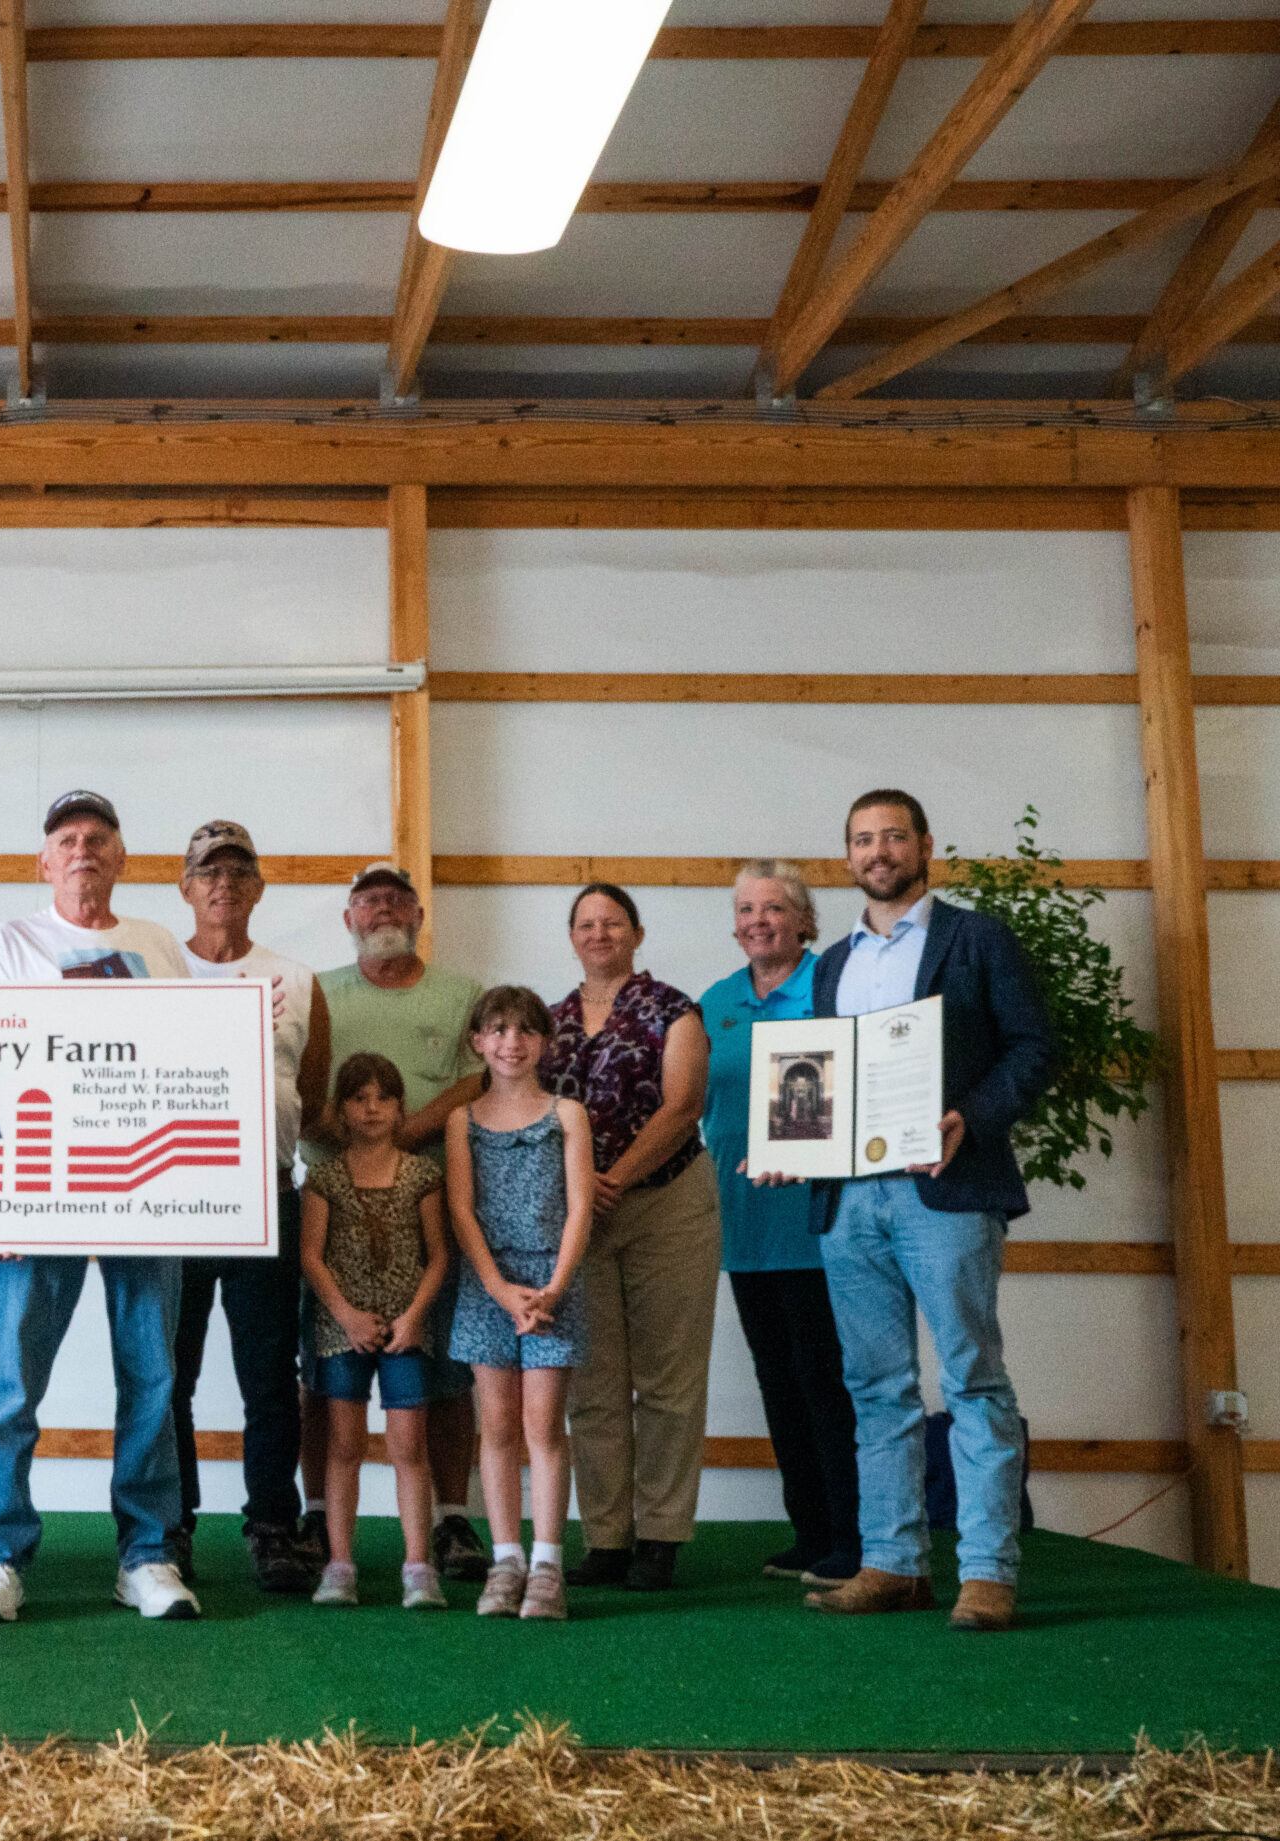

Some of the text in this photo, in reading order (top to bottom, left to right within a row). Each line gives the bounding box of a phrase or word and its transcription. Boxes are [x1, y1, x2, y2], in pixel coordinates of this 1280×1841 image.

[46, 1034, 137, 1063] Farm
[81, 1066, 230, 1081] William J. Farabaugh
[72, 1083, 230, 1097] Richard W. Farabaugh
[99, 1098, 230, 1114] Joseph P. Burkhart
[72, 1116, 148, 1128] Since 1918
[113, 1199, 133, 1214] of
[139, 1199, 243, 1218] Agriculture
